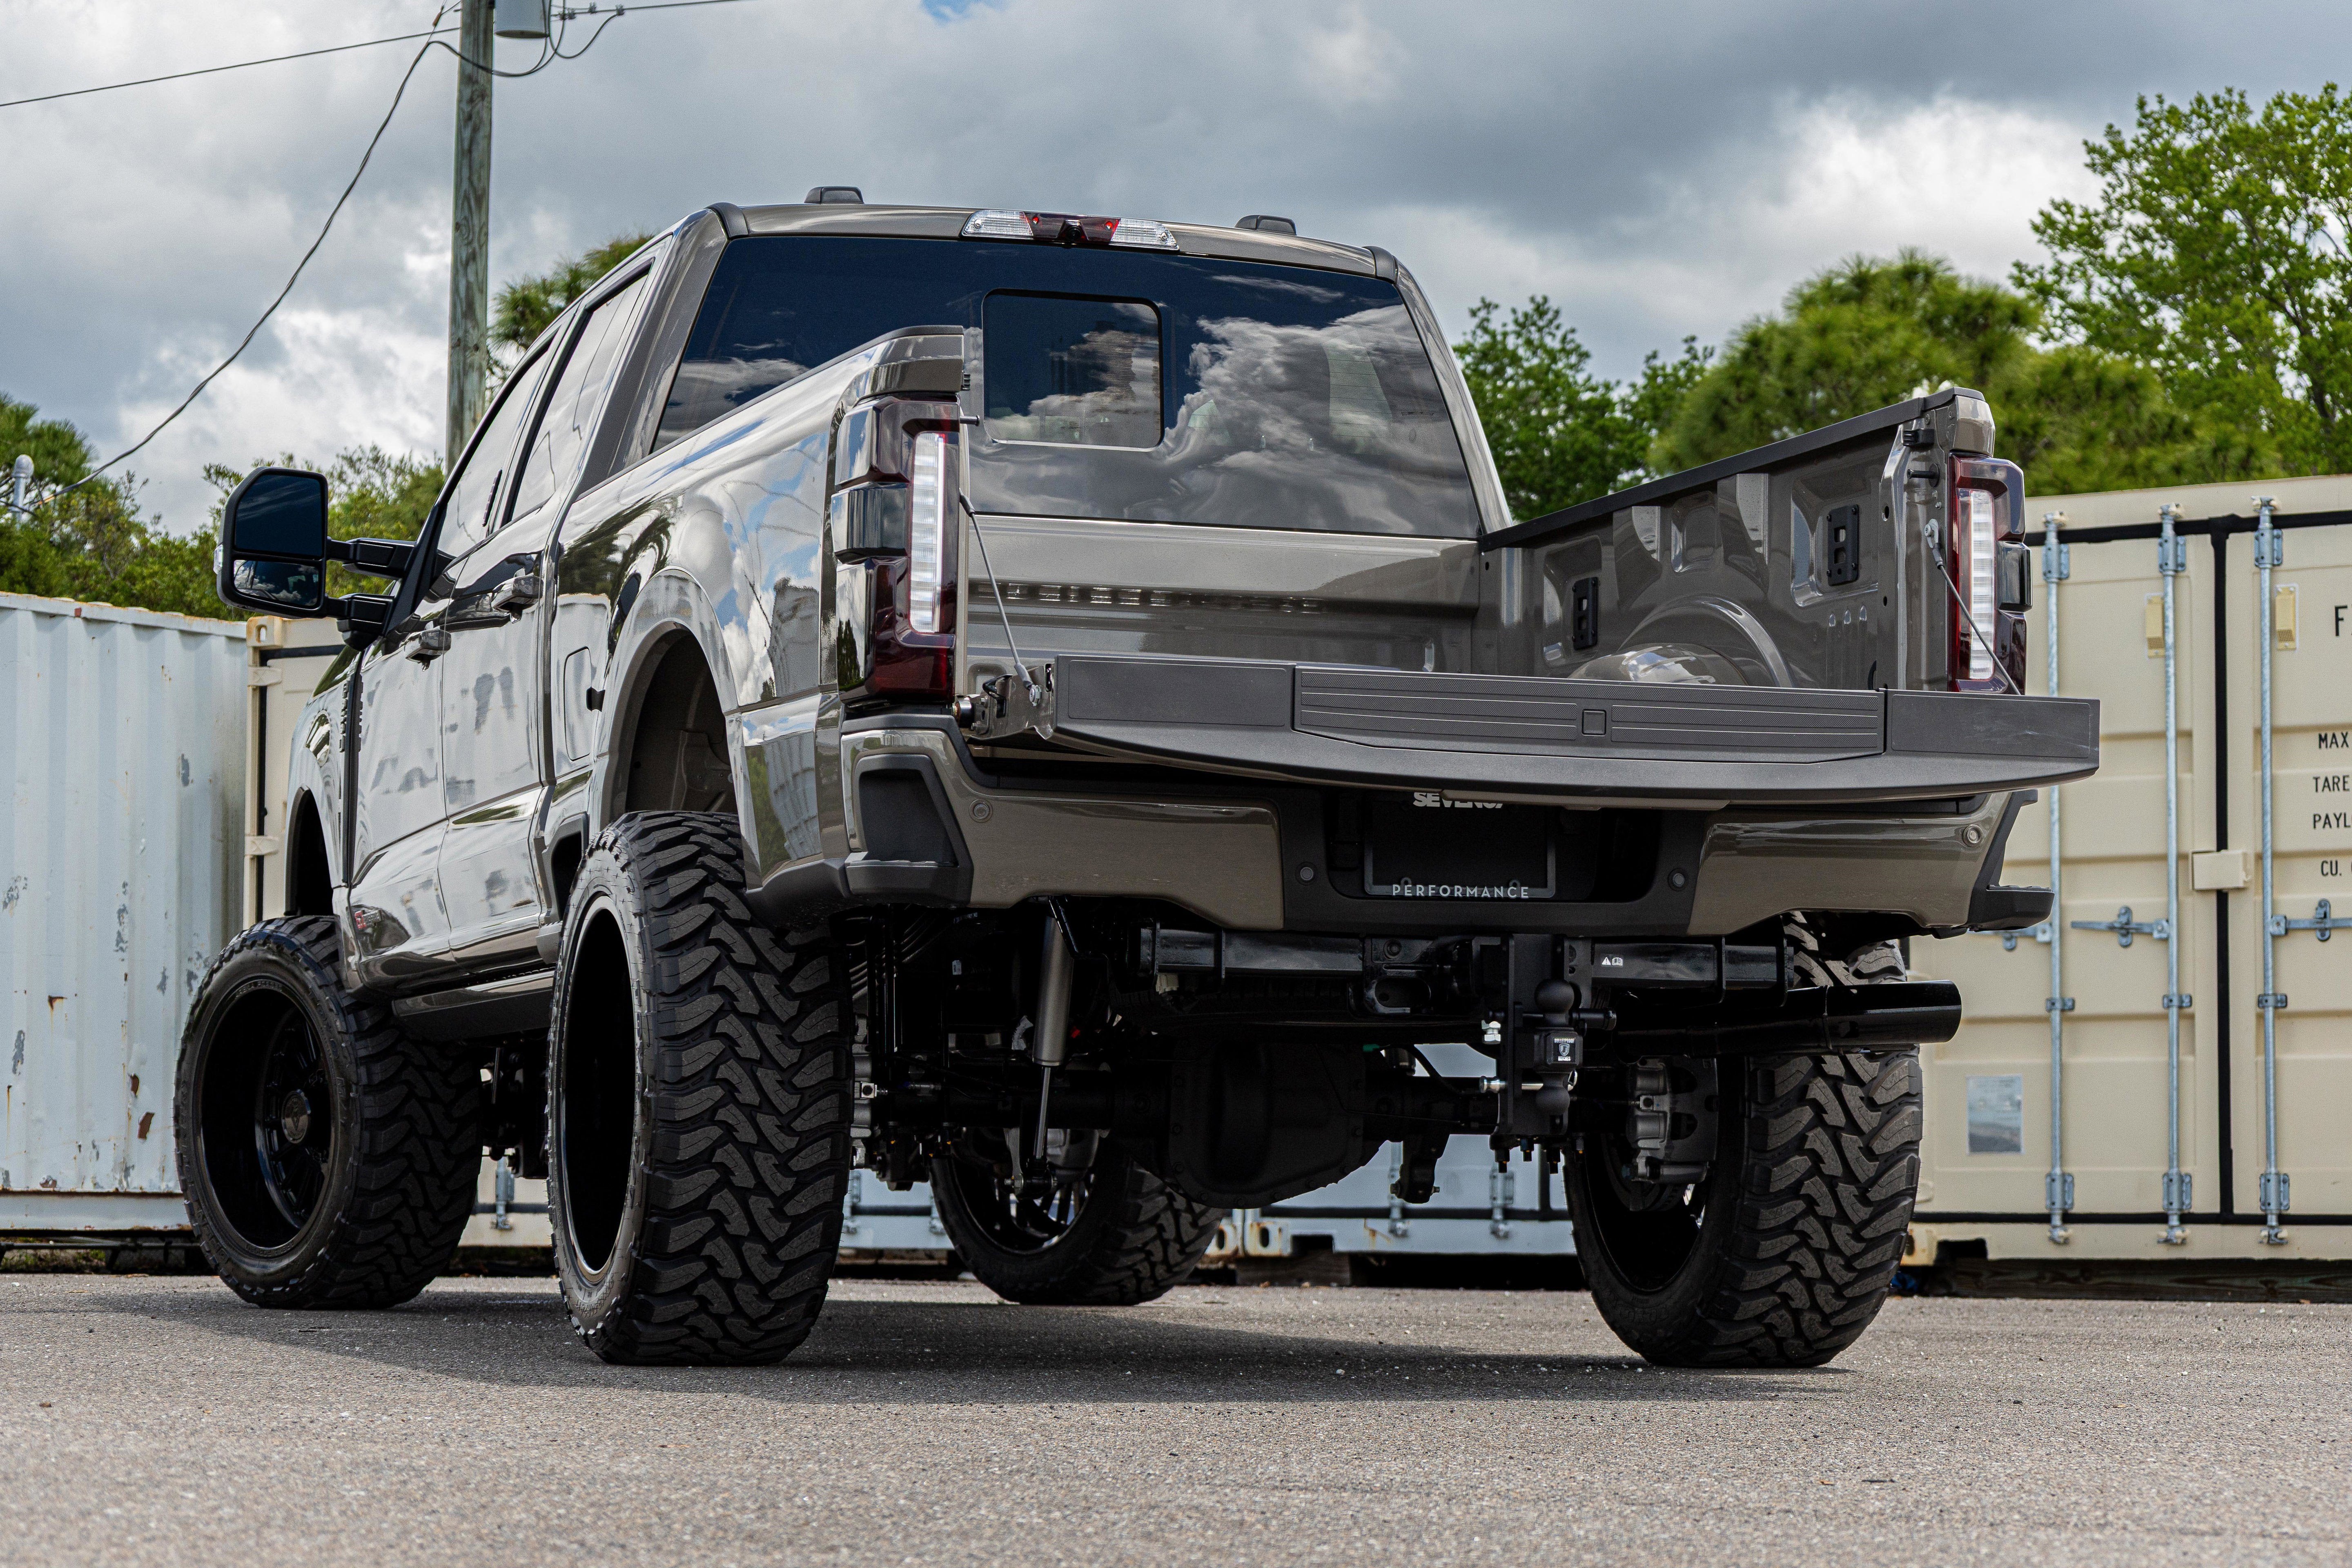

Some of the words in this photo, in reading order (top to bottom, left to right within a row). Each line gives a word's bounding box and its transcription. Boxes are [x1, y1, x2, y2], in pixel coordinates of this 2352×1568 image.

[2334, 605, 2352, 637] F
[2318, 731, 2349, 749] MAX
[2313, 775, 2350, 793] TARE
[2313, 812, 2352, 829] PAYL
[2321, 859, 2342, 877] CU.
[1392, 884, 1529, 898] PERFORMANCE
